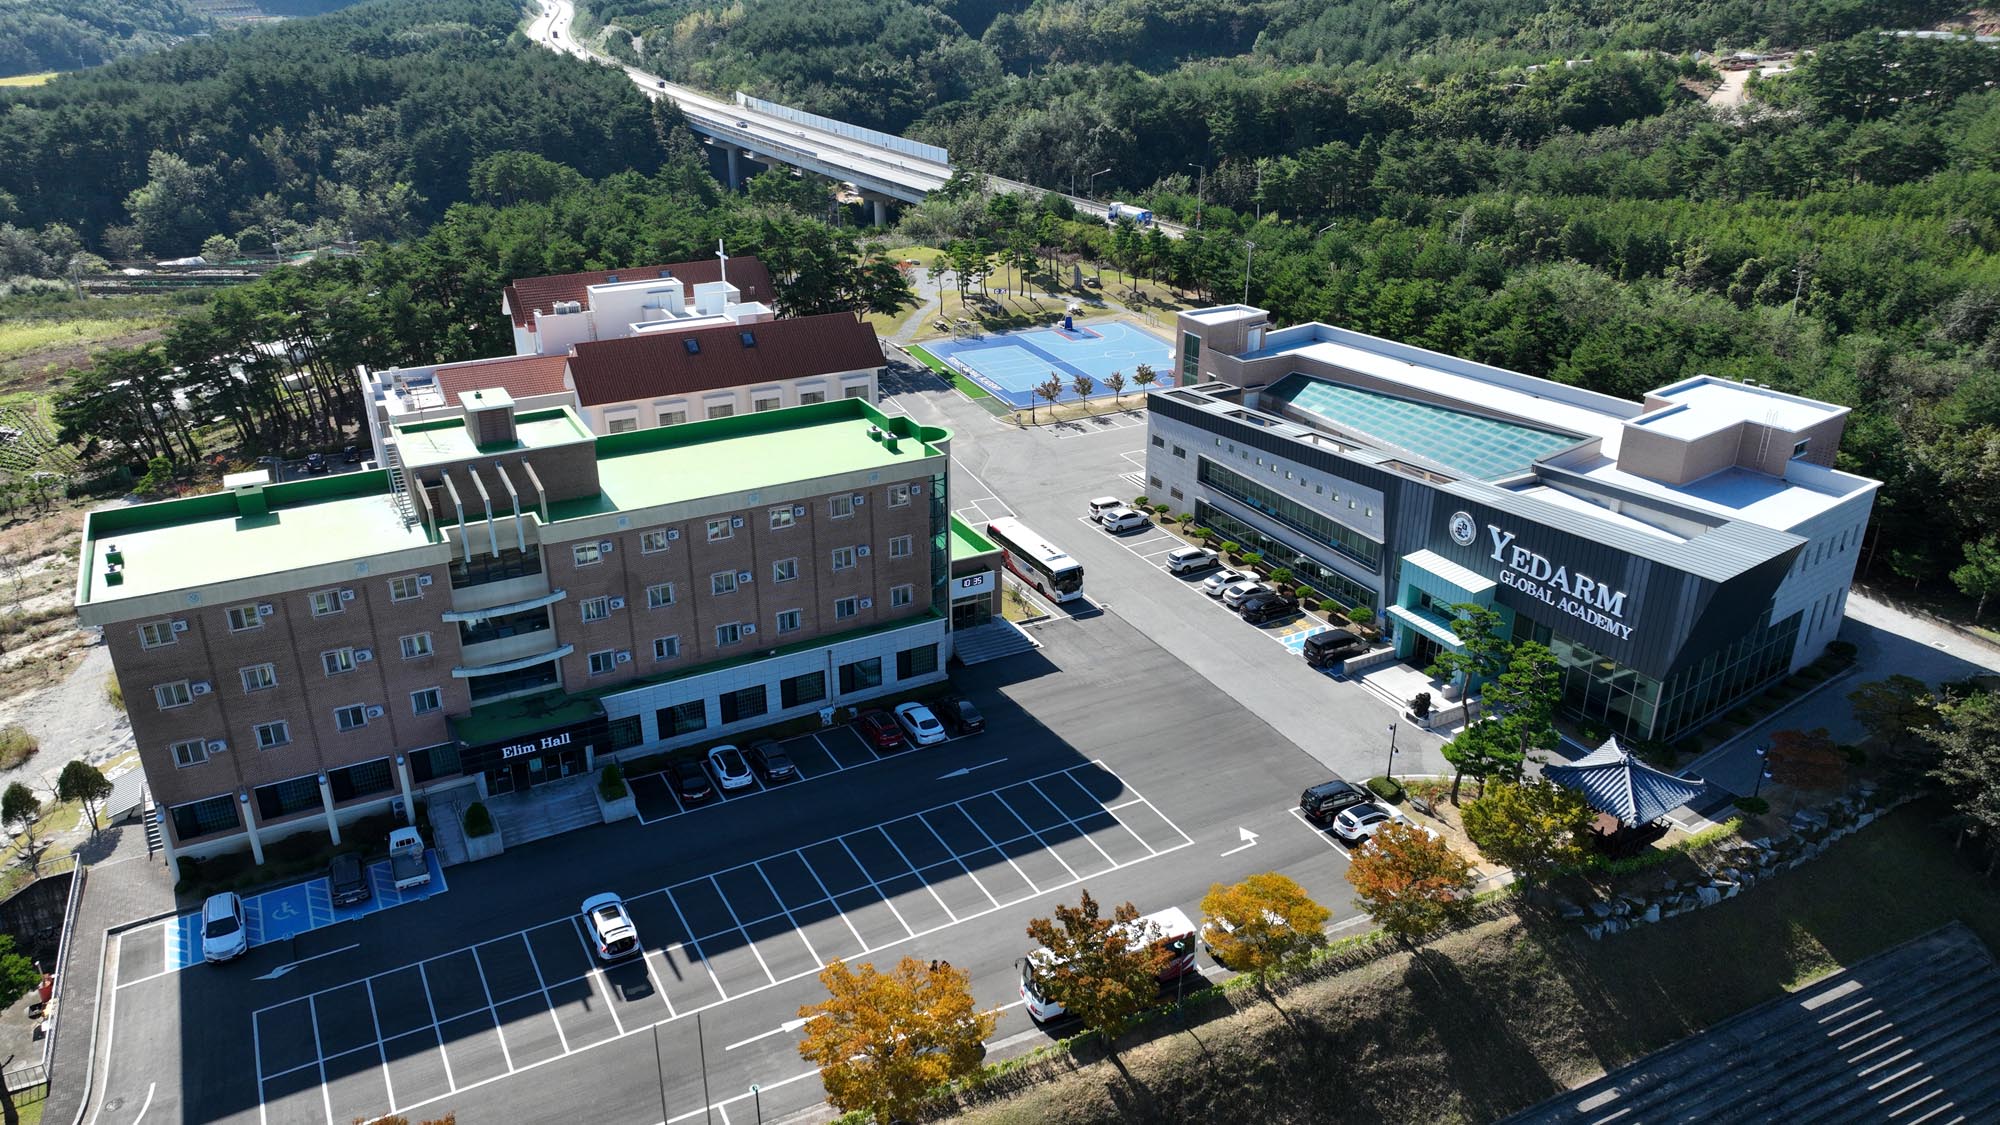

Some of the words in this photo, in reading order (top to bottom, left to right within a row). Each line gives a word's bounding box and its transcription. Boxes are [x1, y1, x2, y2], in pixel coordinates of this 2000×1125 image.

[1487, 524, 1627, 618] YEDARM
[1499, 569, 1555, 606] GLOBAL
[1556, 597, 1633, 641] ACADEMY
[501, 744, 537, 759] Elim
[540, 732, 571, 750] Hall
